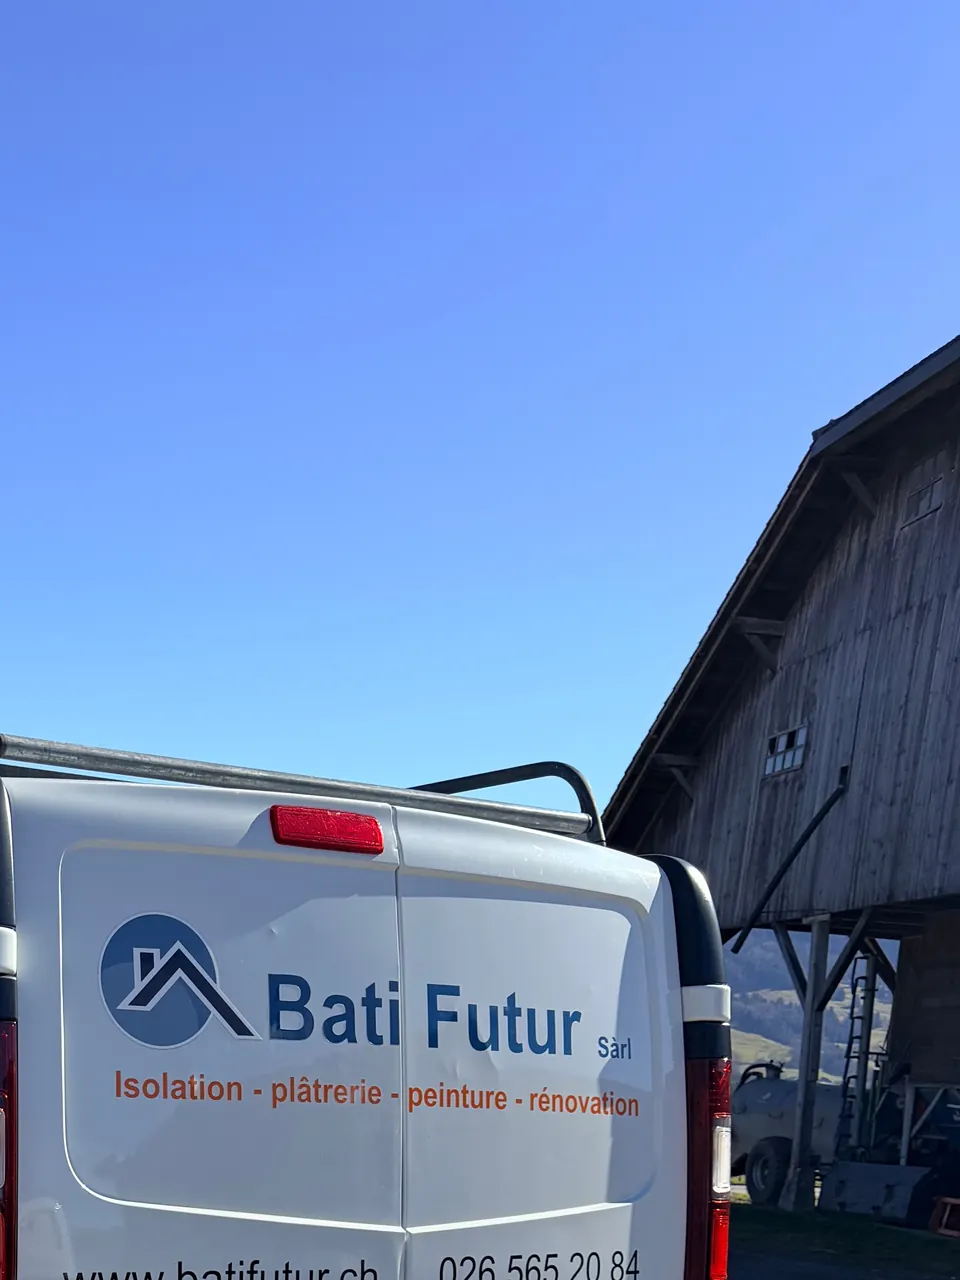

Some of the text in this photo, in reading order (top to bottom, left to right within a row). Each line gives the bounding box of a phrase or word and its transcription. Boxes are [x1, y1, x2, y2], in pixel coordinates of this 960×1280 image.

[268, 973, 632, 1060] Bati Futur Sàrl
[114, 1070, 242, 1101] Isolation
[271, 1076, 382, 1109] plâtrerie
[408, 1082, 507, 1114] peinture
[529, 1087, 639, 1117] rénovation
